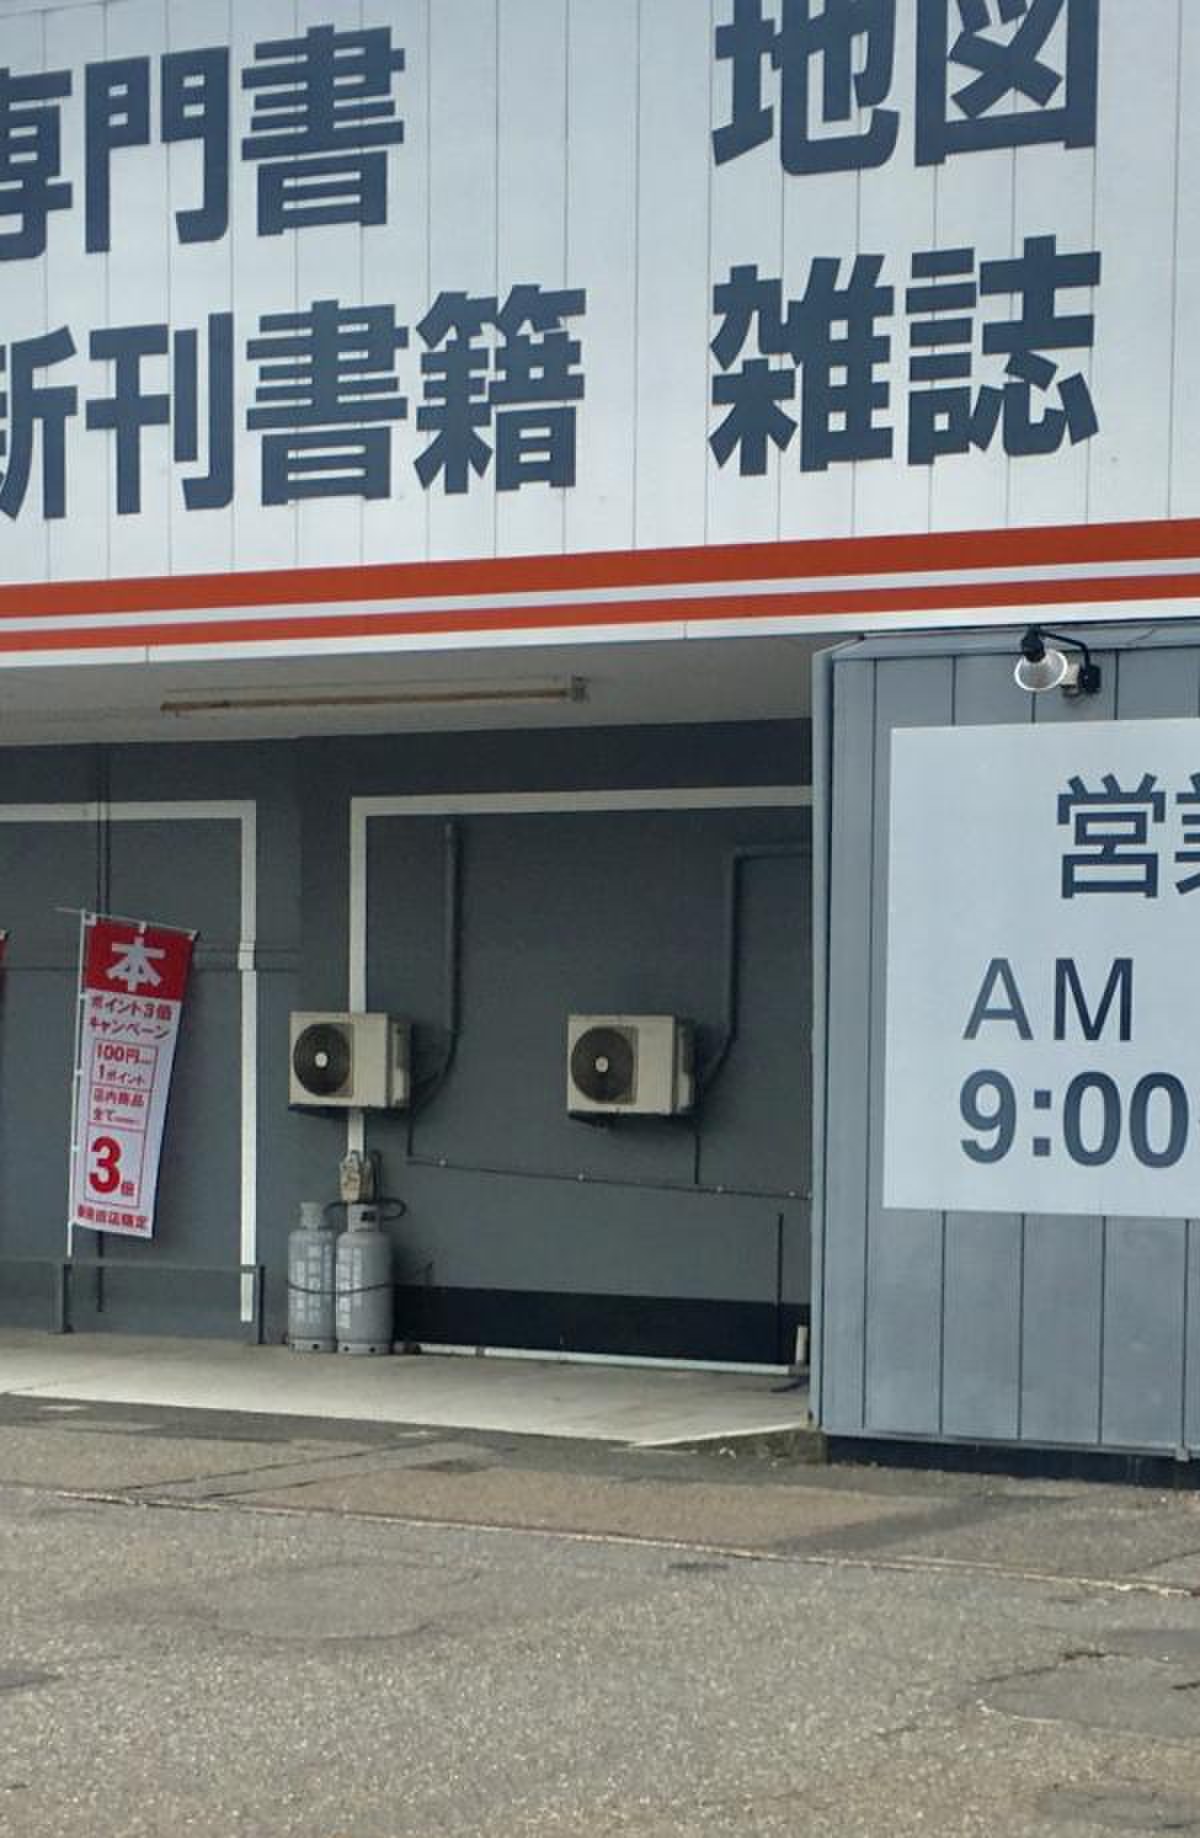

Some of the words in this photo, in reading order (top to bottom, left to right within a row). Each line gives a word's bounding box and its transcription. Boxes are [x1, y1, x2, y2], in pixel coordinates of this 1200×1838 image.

[712, 0, 1100, 176] 地図
[709, 234, 1101, 476] 雑誌
[106, 936, 165, 992] 本
[962, 957, 1134, 1042] AM
